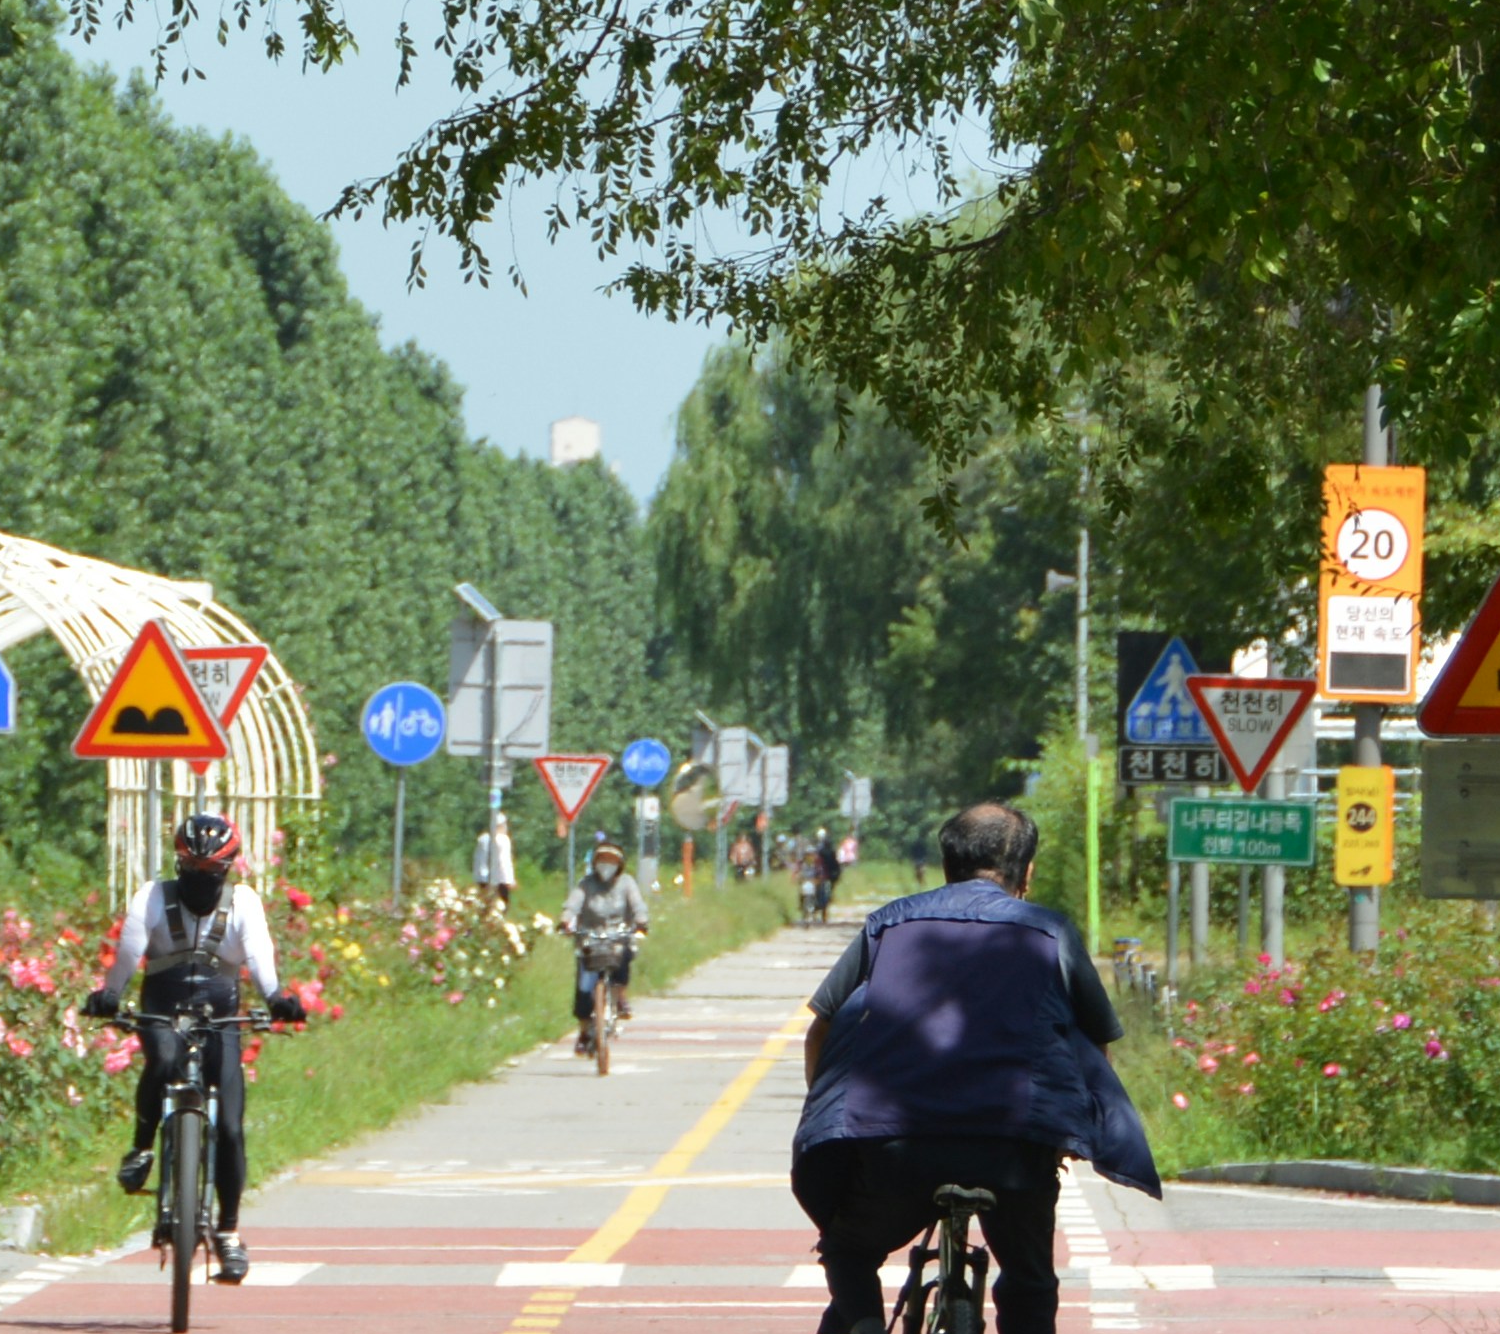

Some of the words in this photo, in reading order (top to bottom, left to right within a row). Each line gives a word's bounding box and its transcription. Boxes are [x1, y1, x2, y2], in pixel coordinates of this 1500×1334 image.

[1350, 528, 1394, 561] 20
[1346, 605, 1395, 622] 당신의
[1336, 624, 1365, 641] 현재
[1373, 625, 1405, 642] 속도
[1219, 691, 1284, 715] 천천히
[1227, 717, 1274, 734] SLOW
[1127, 750, 1220, 781] 천천히
[1237, 839, 1282, 856] 100m
